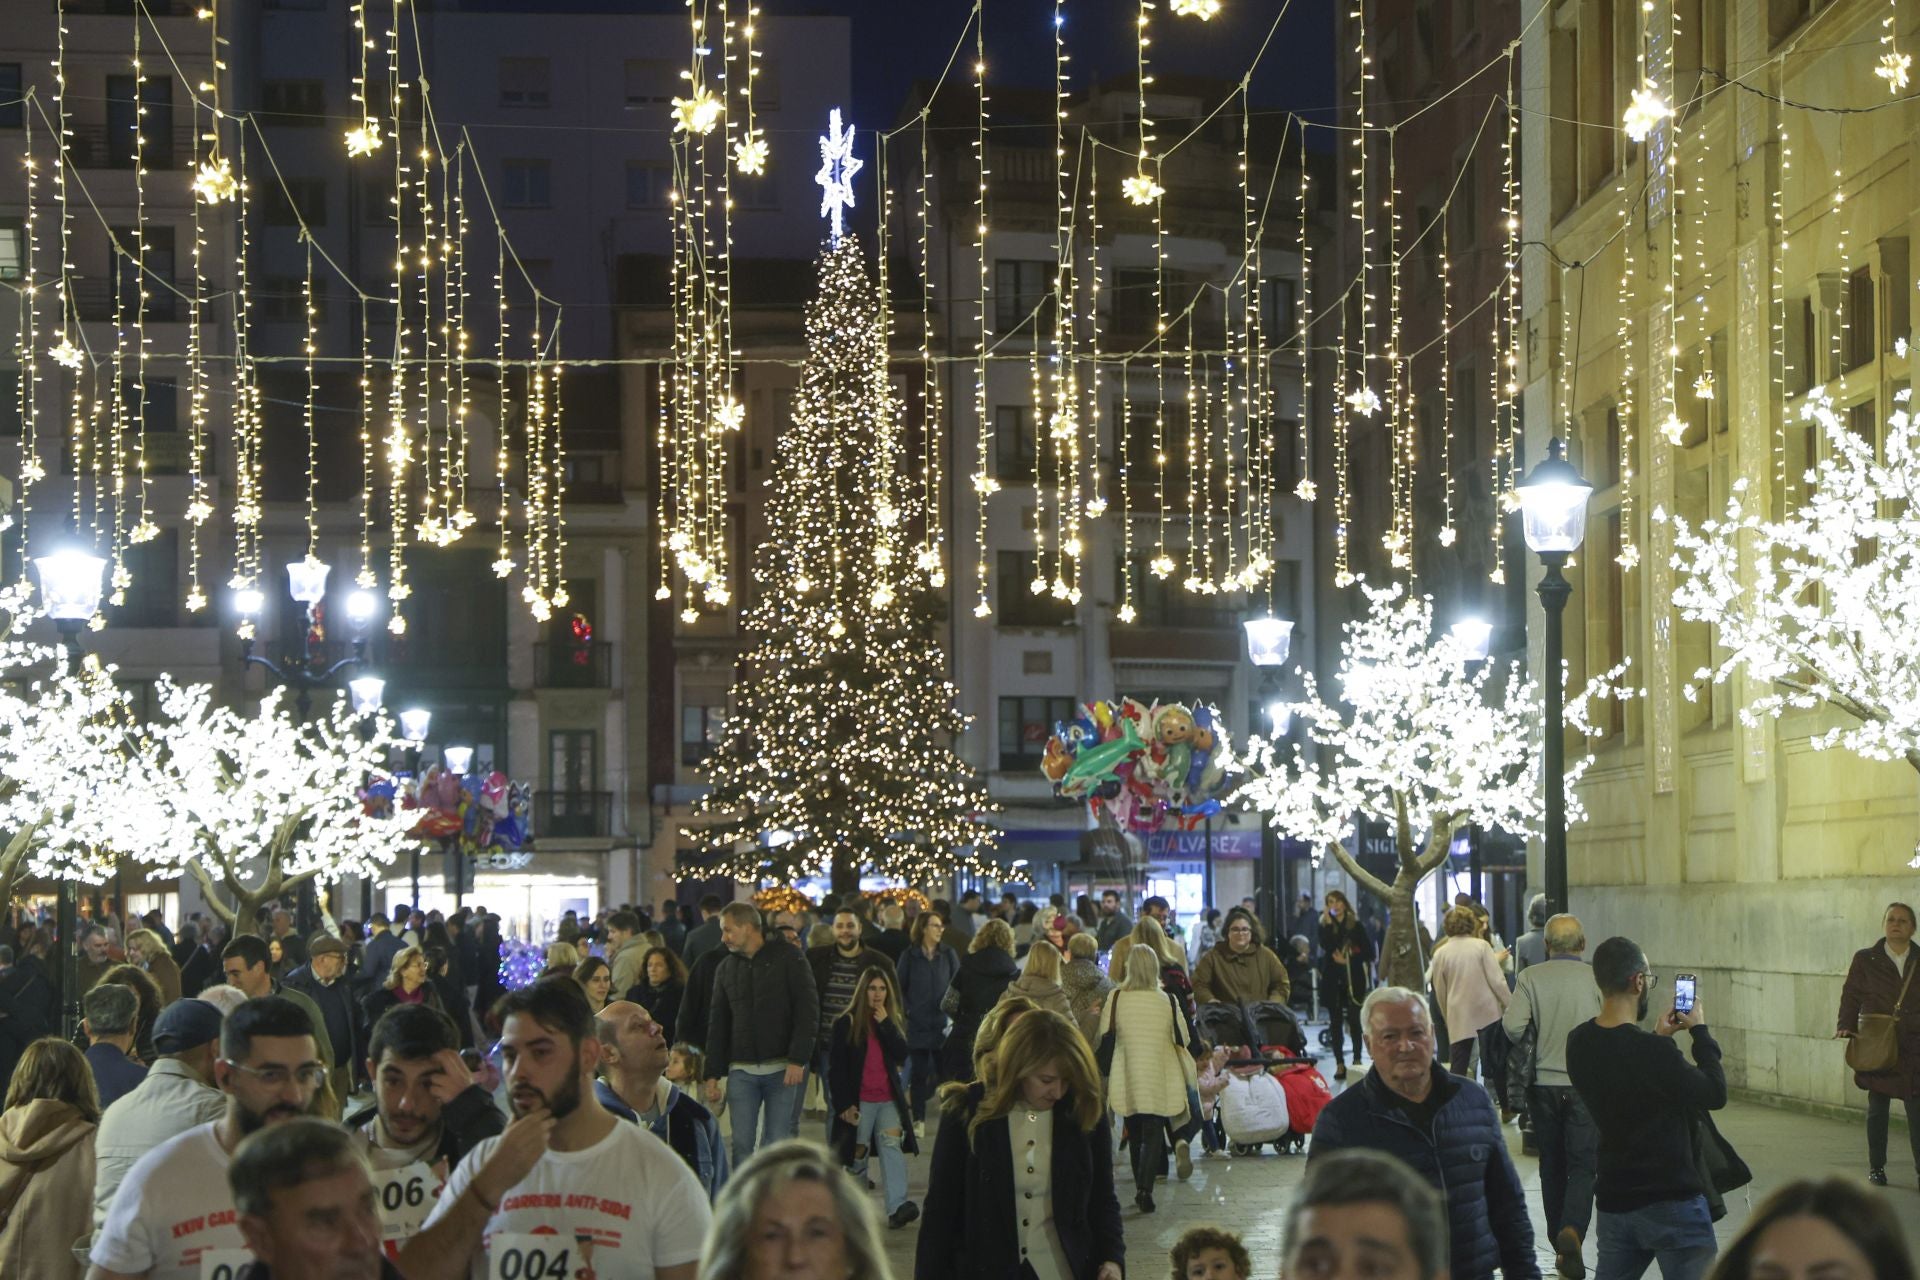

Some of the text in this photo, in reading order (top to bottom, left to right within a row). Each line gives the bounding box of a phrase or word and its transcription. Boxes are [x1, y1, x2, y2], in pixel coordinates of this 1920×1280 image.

[1149, 835, 1240, 853] CIALVAREZ
[376, 1176, 424, 1211] 06
[504, 1193, 562, 1212] CARRERA
[566, 1193, 632, 1221] ANTI-SIDA
[208, 1209, 237, 1228] CAR
[500, 1248, 569, 1280] 004
